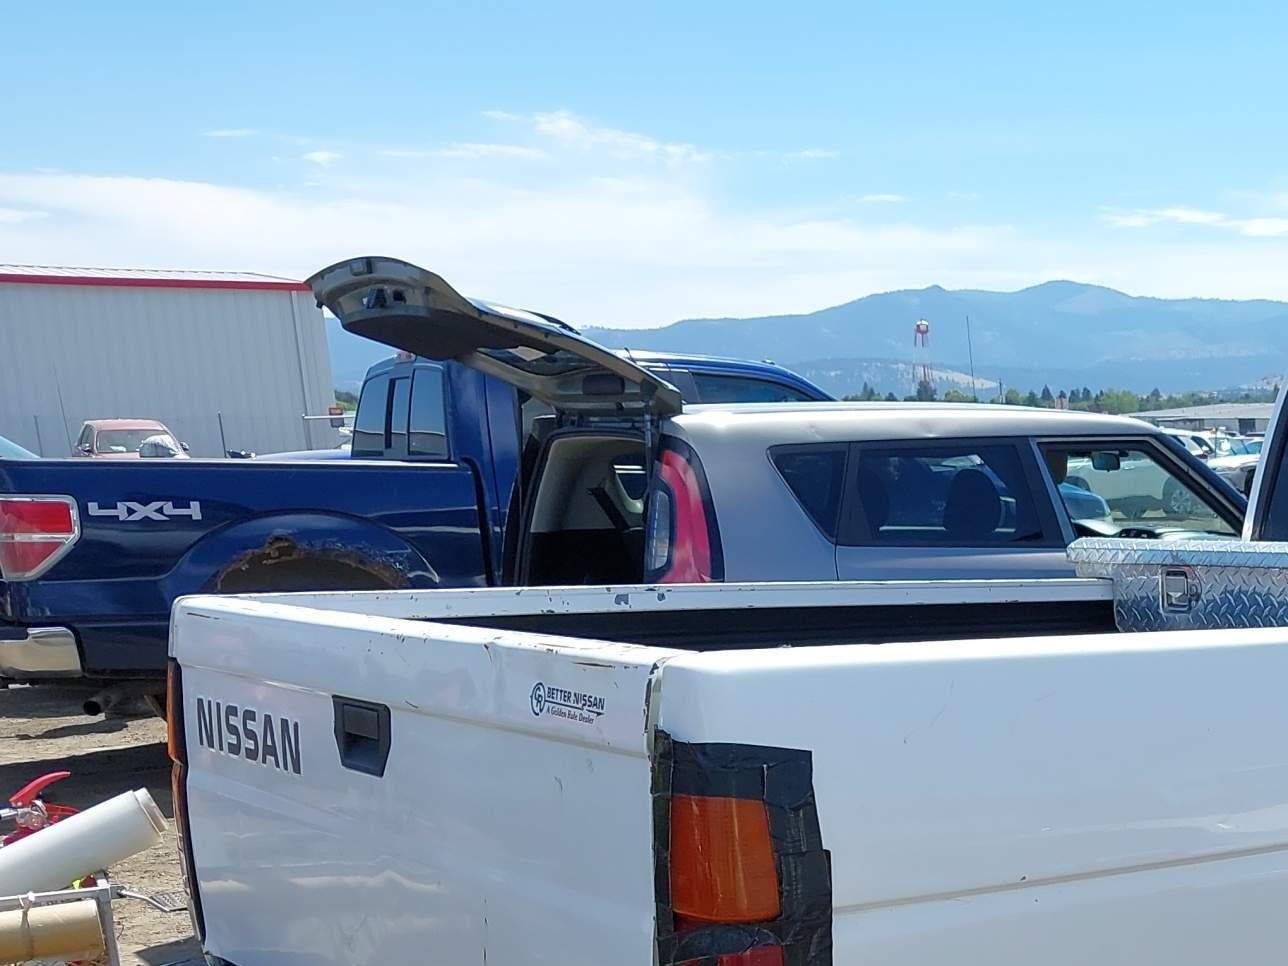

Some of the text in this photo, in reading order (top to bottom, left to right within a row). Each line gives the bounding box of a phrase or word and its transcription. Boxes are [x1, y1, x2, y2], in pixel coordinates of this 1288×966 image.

[547, 686, 605, 711] BETTER NISSAN
[551, 706, 567, 719] Golden
[567, 710, 578, 721] Rule
[578, 713, 595, 724] Dealer
[197, 697, 301, 775] NISSAN
